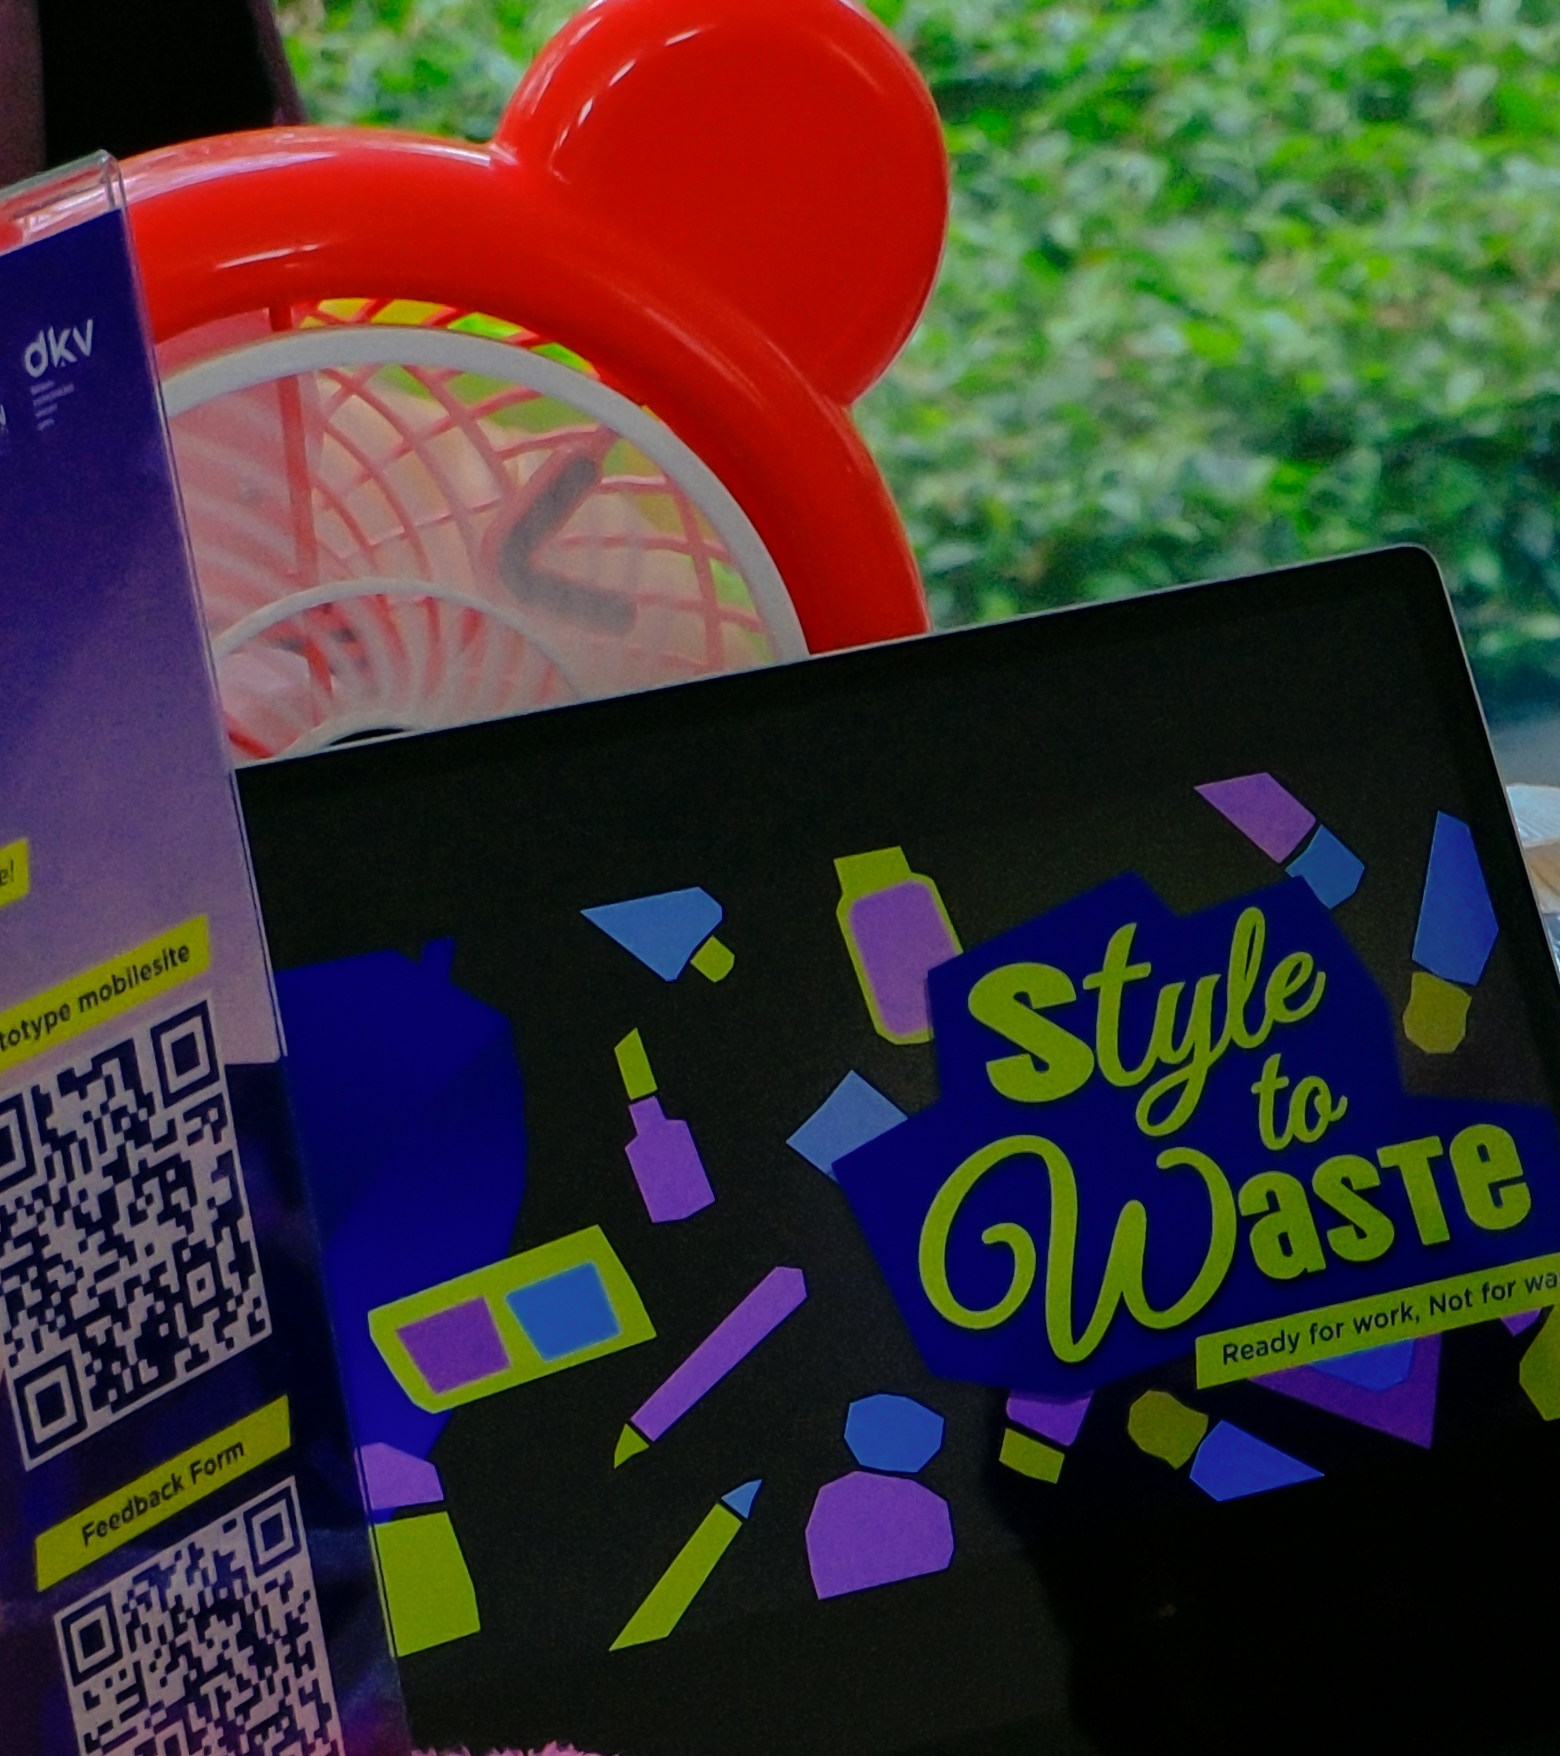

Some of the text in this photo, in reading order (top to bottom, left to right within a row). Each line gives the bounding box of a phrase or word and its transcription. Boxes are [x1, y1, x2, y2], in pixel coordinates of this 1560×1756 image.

[76, 941, 192, 1022] mobilesite
[968, 907, 1326, 1136] Style
[1251, 1052, 1348, 1152] to
[1221, 1328, 1302, 1368] Ready
[1308, 1318, 1346, 1348] for
[1352, 1300, 1422, 1339] work,
[1428, 1286, 1475, 1316] Not
[1480, 1274, 1518, 1303] for
[81, 1441, 246, 1547] Feedback Form
